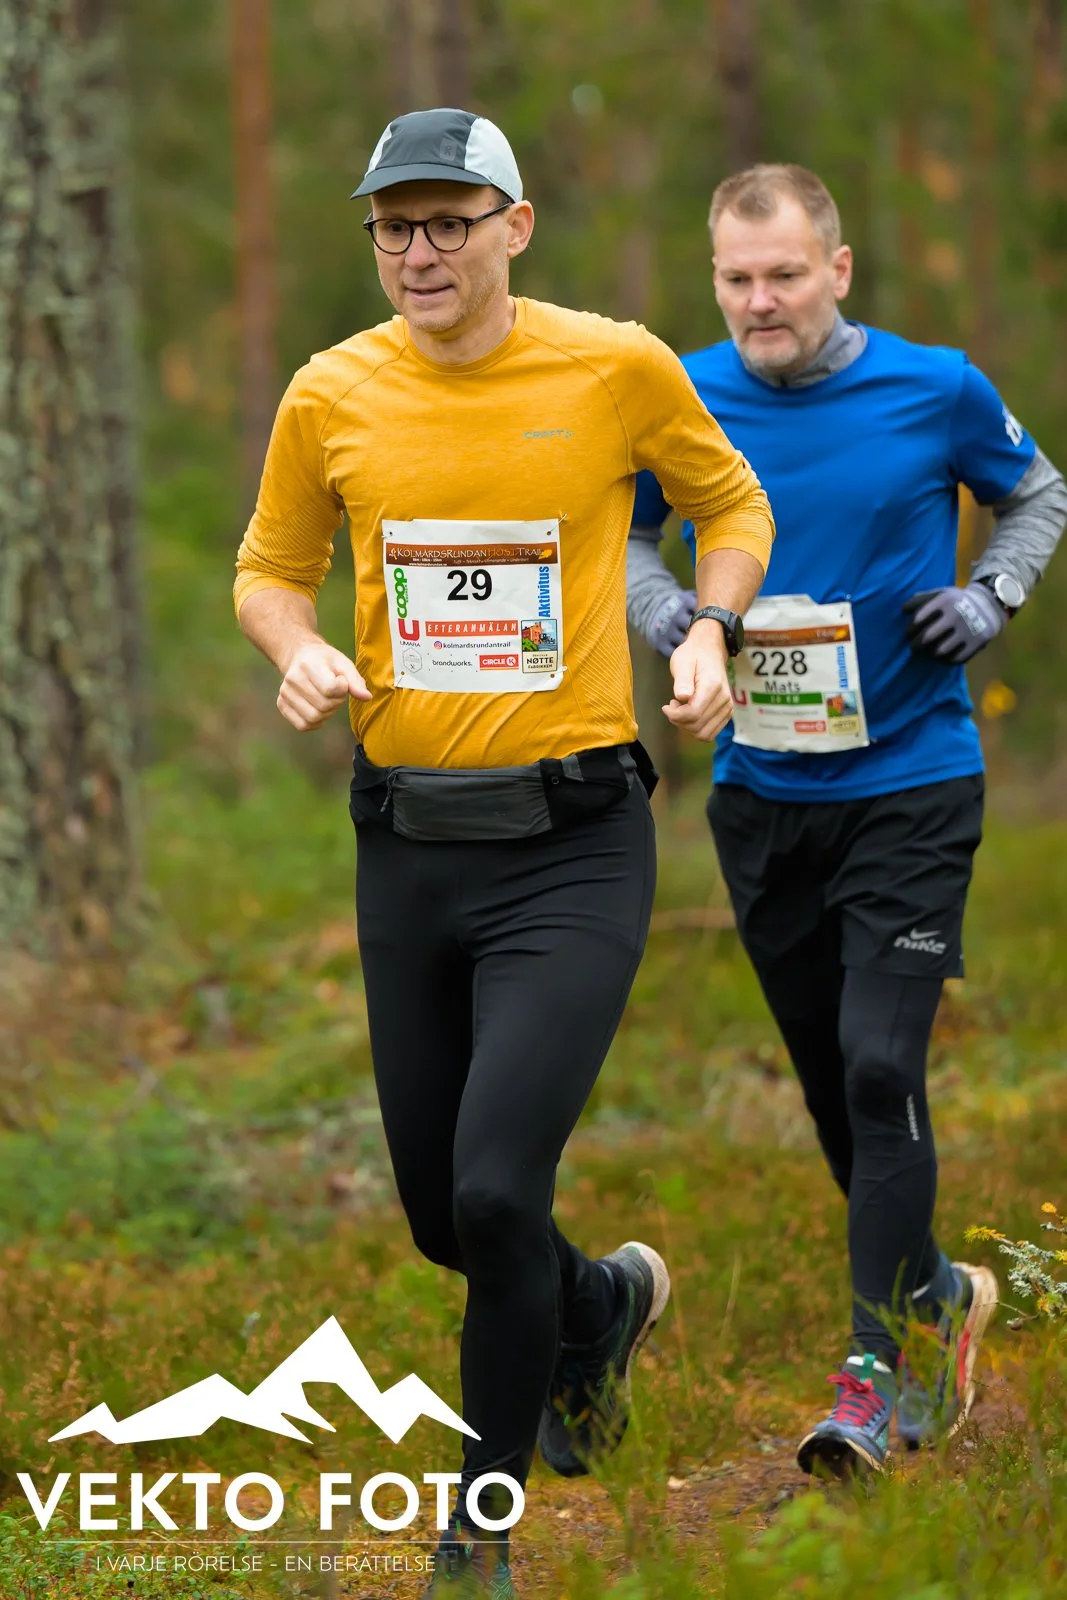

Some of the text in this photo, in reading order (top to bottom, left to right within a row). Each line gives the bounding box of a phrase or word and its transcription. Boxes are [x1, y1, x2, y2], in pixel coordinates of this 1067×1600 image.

[524, 429, 564, 439] CRAFT
[447, 569, 492, 601] 29
[538, 566, 551, 618] Aktivitus
[427, 622, 517, 633] EFTERANMÄLAN
[443, 641, 511, 649] kolmardsrundantrail
[526, 657, 554, 665] NØTTE
[751, 650, 808, 676] 228
[764, 681, 801, 693] Mats
